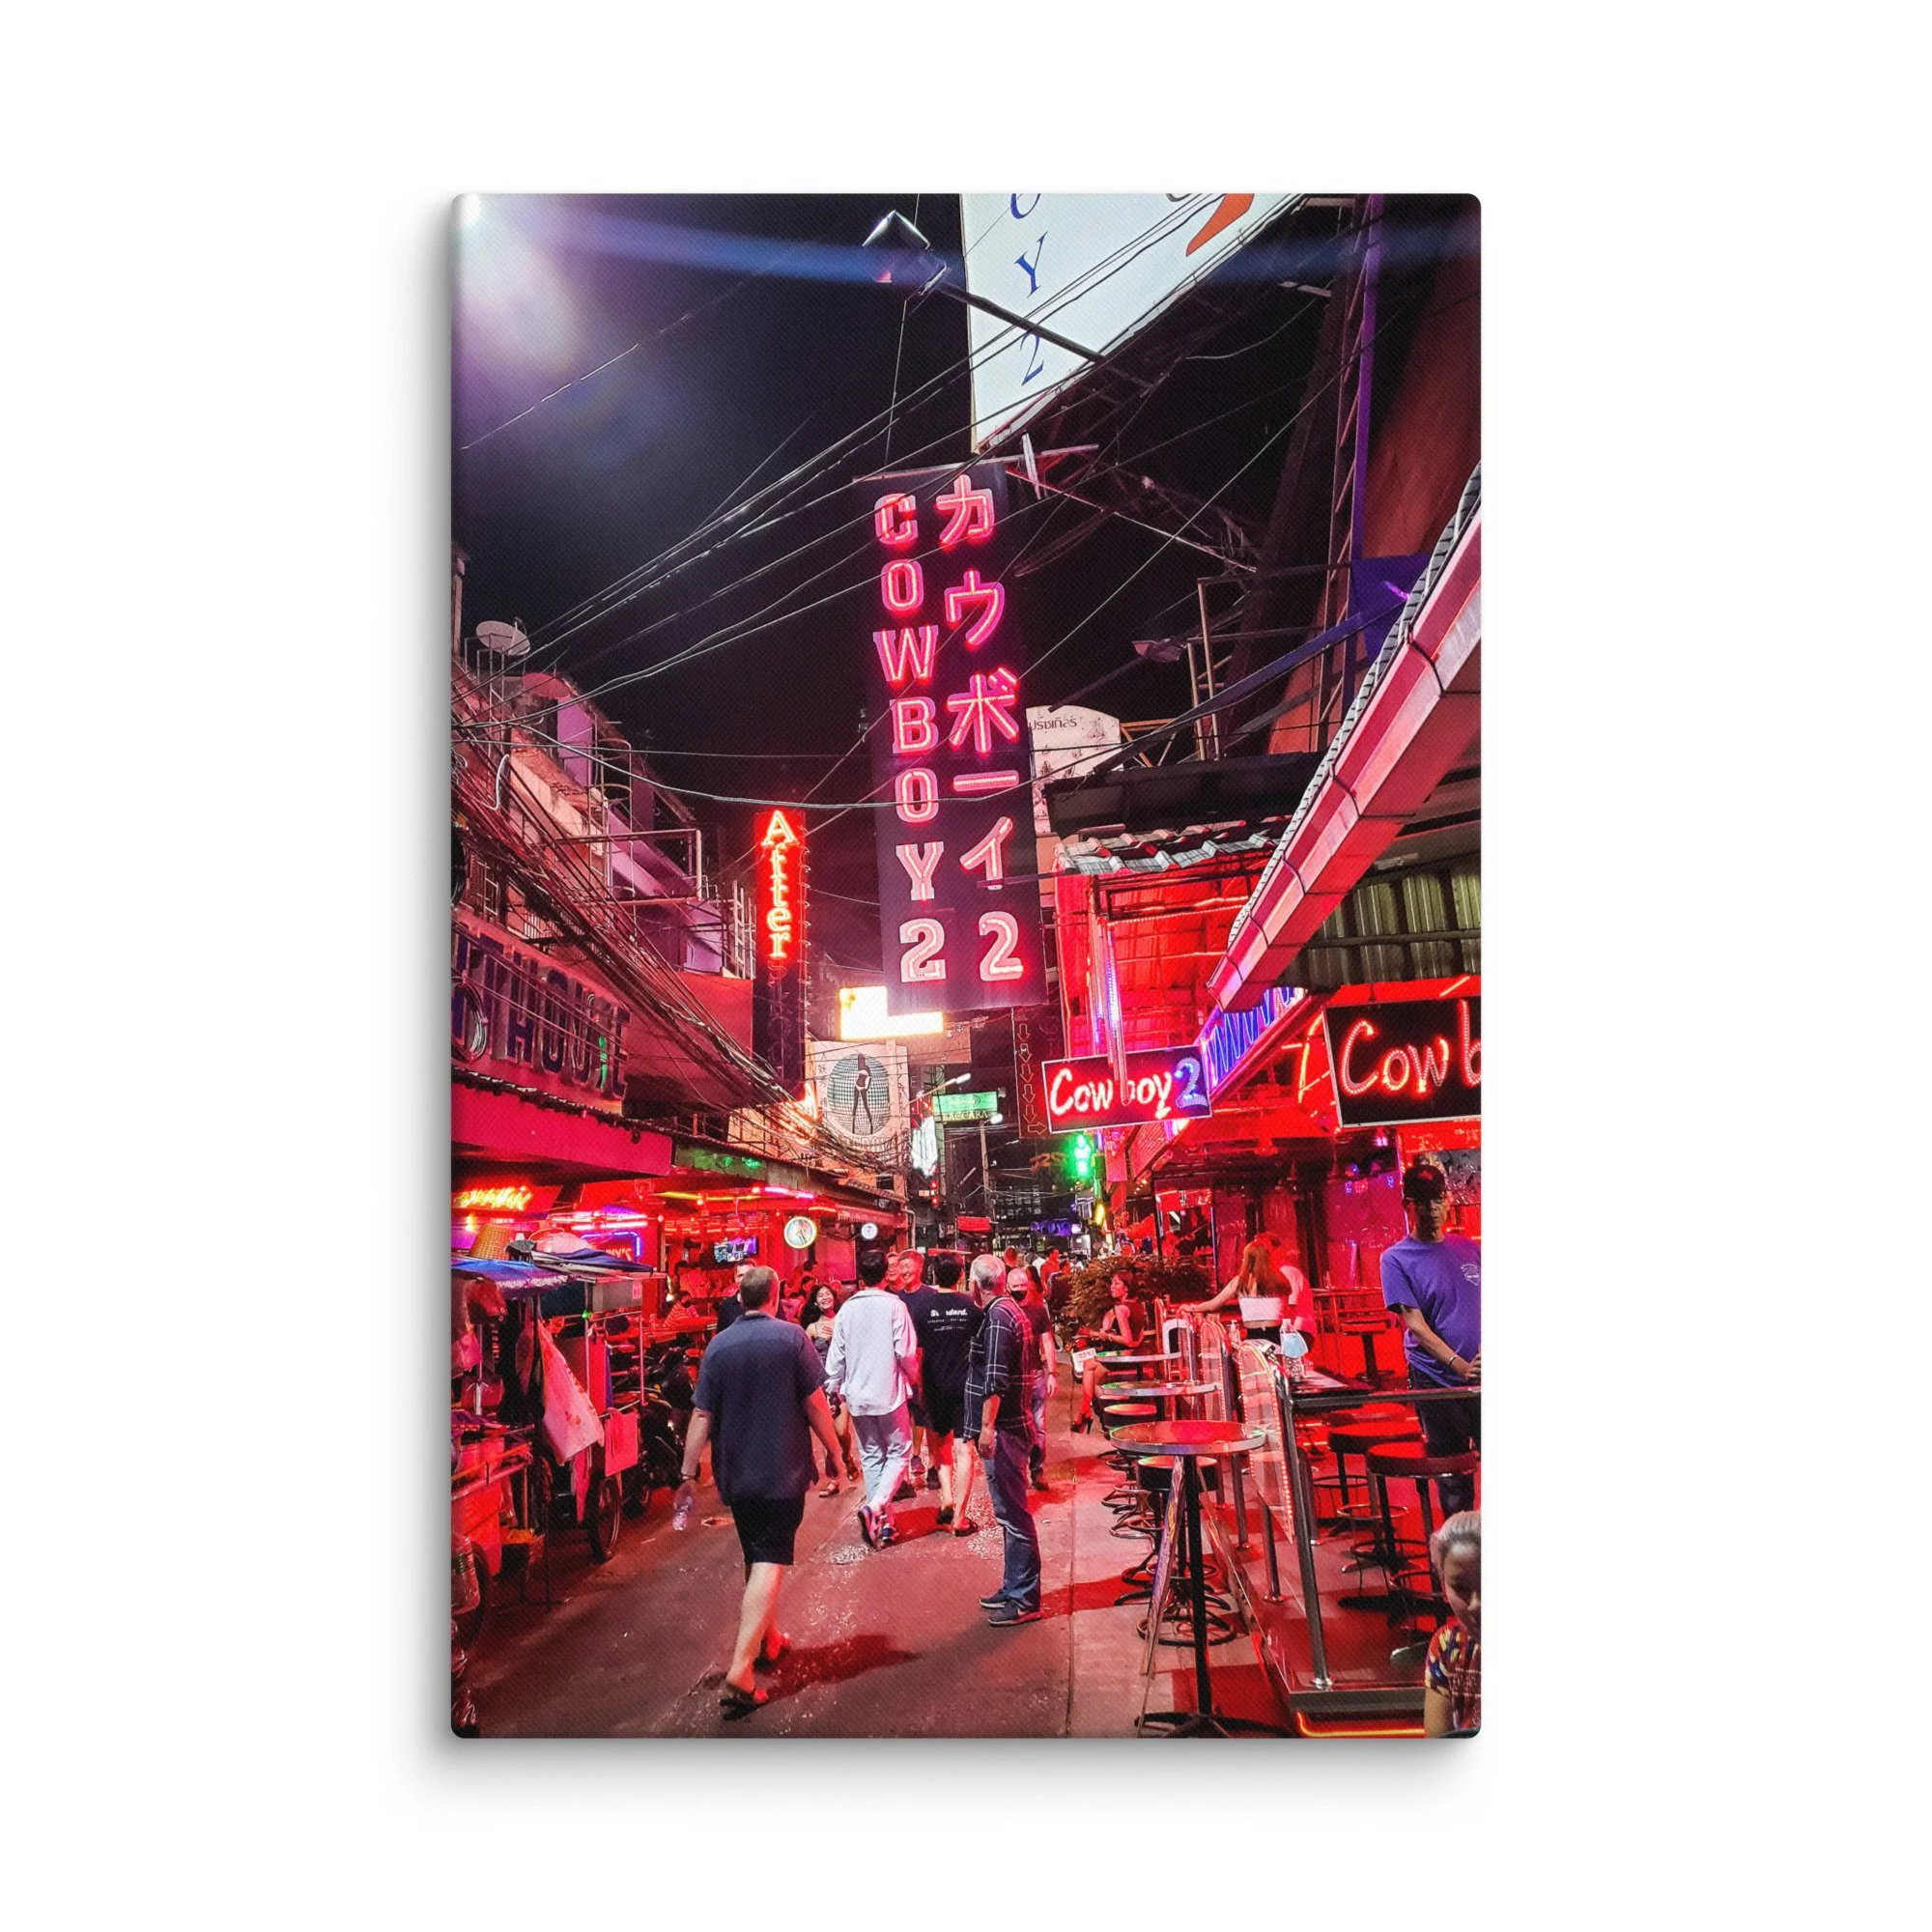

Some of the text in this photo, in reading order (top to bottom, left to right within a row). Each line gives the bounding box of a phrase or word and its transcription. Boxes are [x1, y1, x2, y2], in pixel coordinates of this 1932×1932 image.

[761, 809, 799, 958] After
[1342, 999, 1481, 1094] Cowb
[941, 1109, 990, 1122] BACCARA
